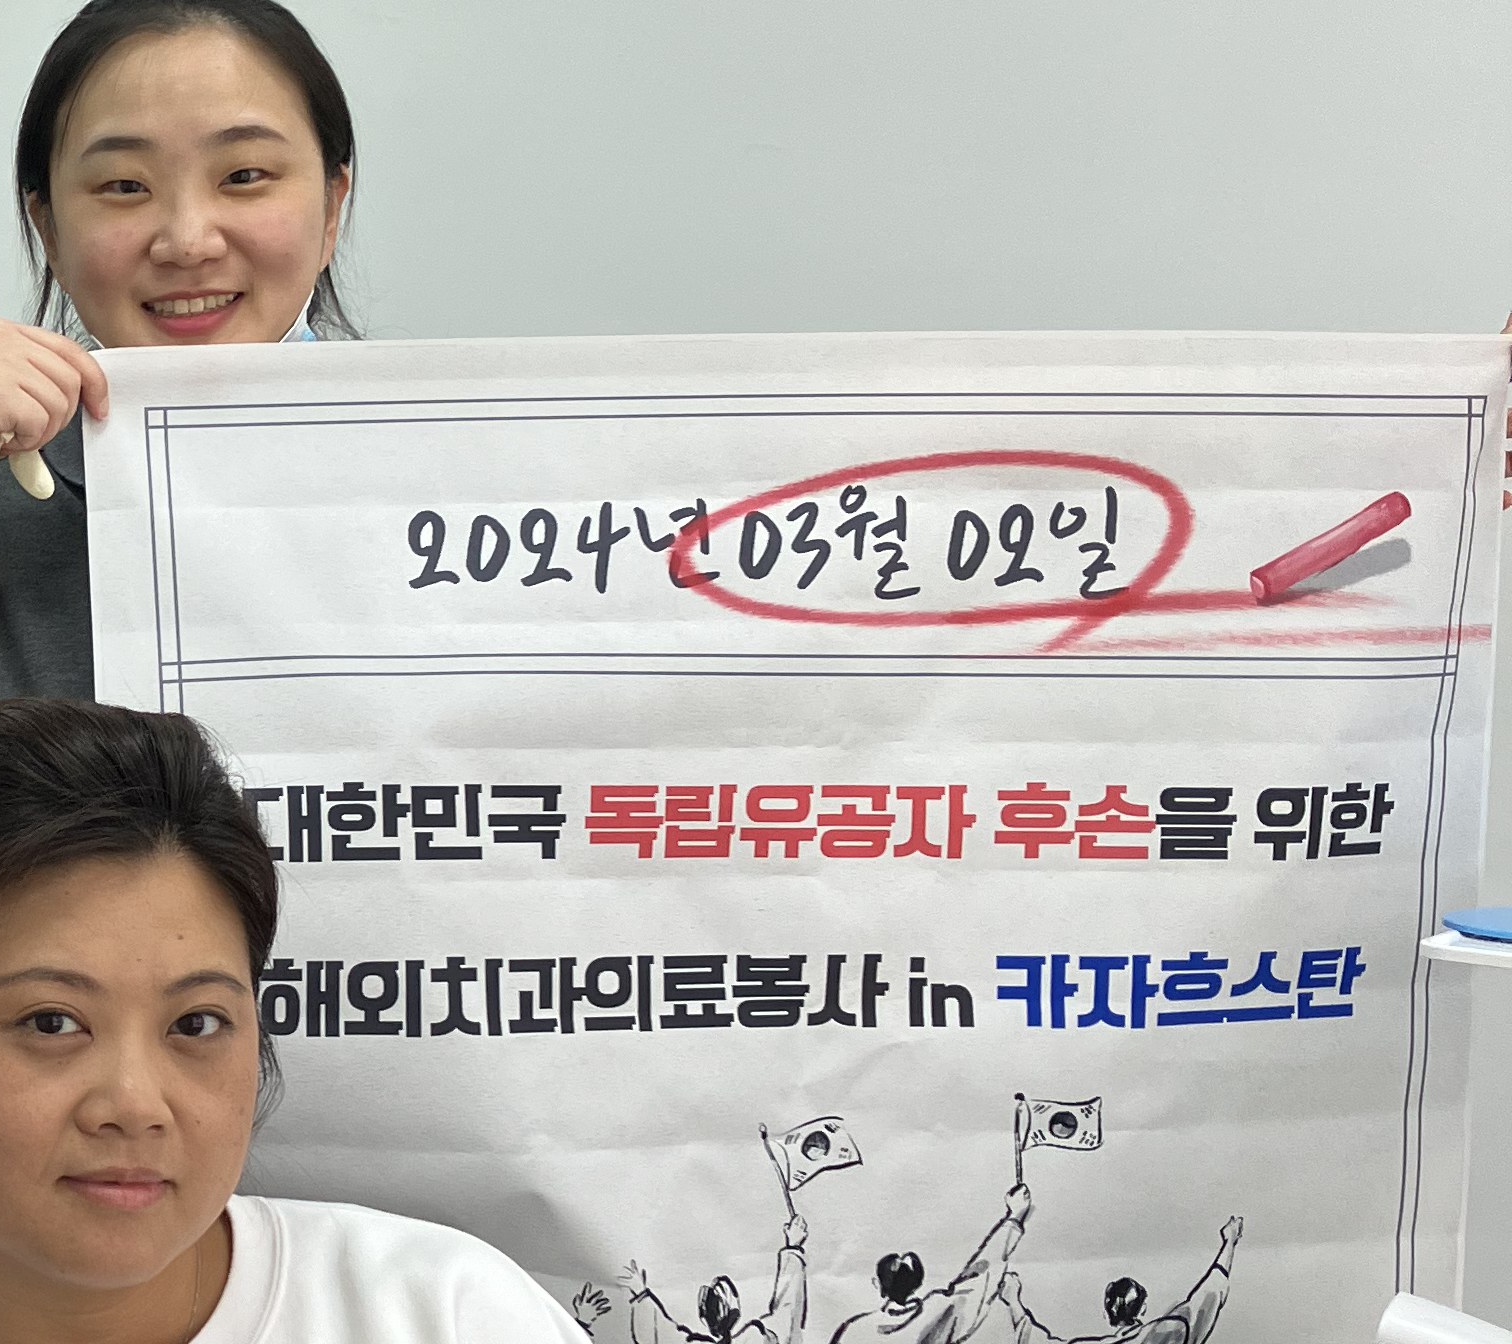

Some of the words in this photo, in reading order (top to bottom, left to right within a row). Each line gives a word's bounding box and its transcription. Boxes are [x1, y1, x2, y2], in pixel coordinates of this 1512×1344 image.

[408, 498, 720, 594] 2024년
[739, 484, 921, 600] 03월
[946, 485, 1130, 600] 02일
[242, 781, 567, 863] 대한민국
[584, 782, 976, 860] 독립유공자
[993, 781, 1237, 860] 후손을
[1255, 781, 1394, 861] 위한
[260, 954, 889, 1037] 해외치과의료봉사
[908, 956, 975, 1027] in
[996, 946, 1366, 1030] 카자흐스탄
